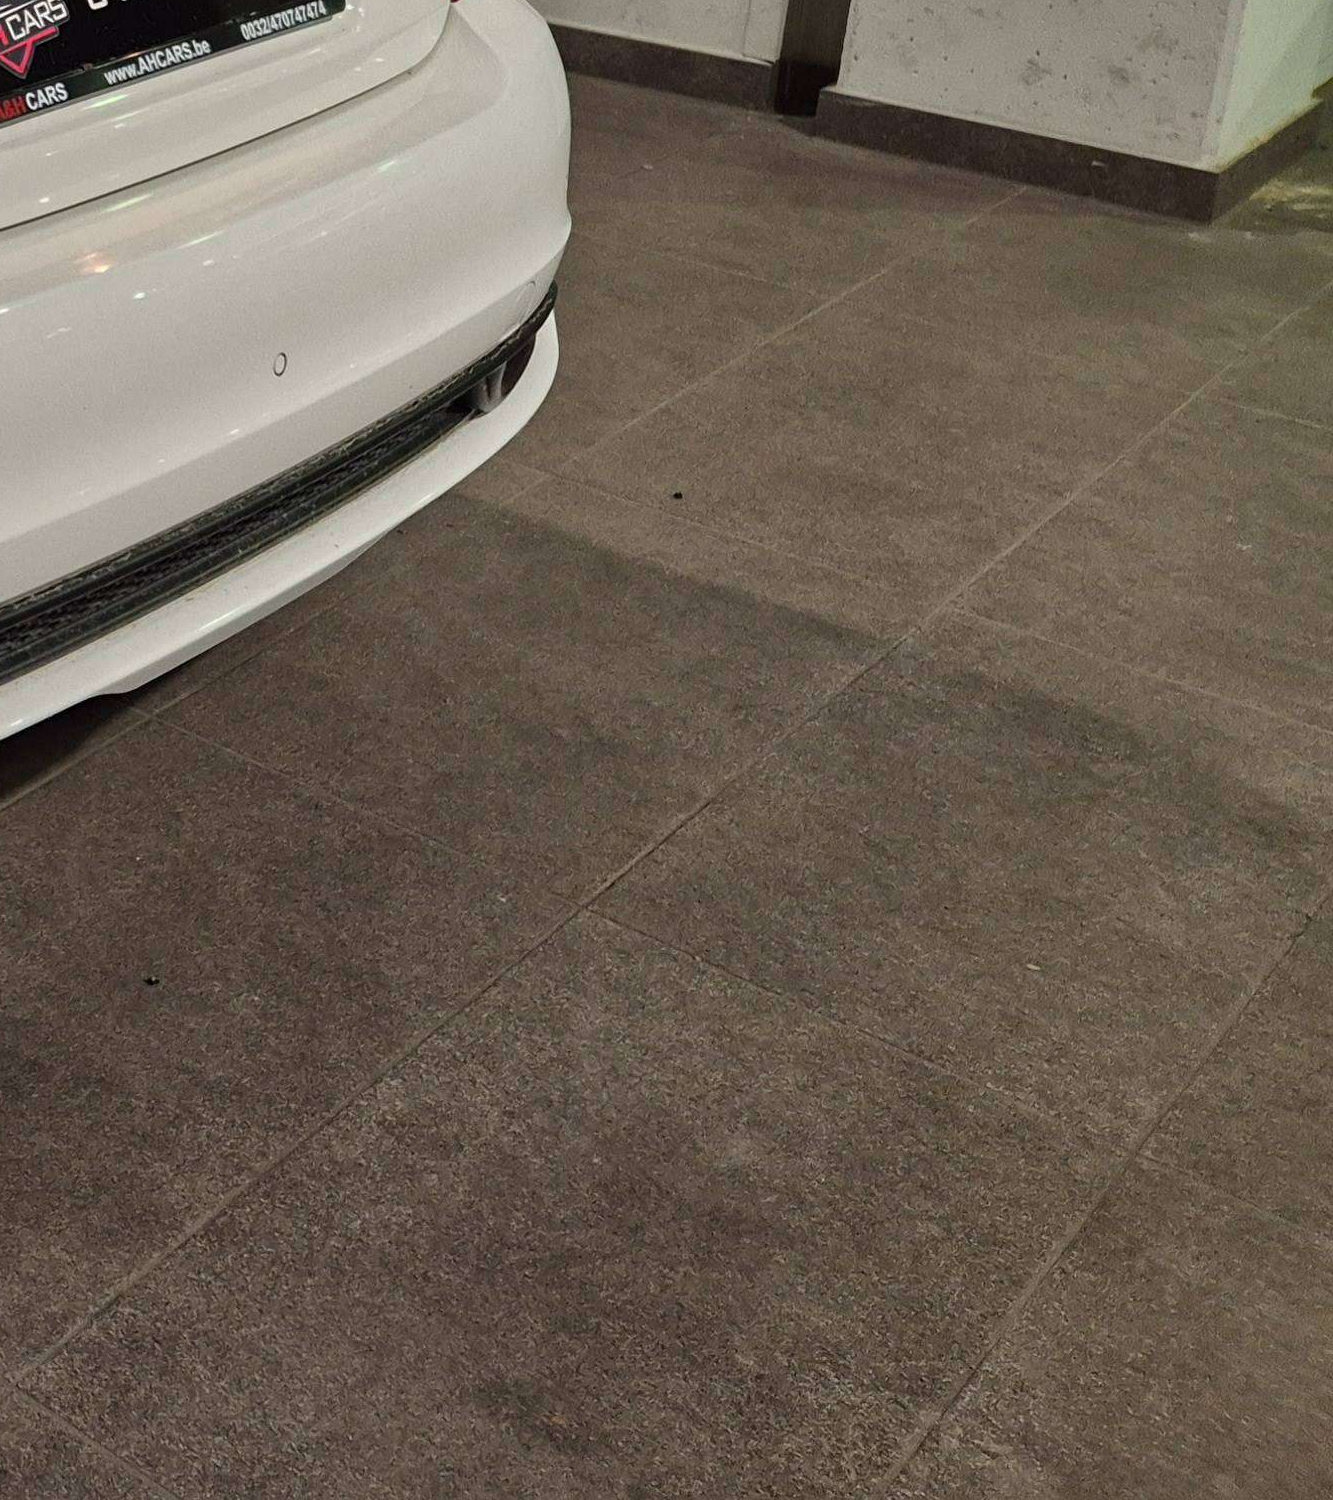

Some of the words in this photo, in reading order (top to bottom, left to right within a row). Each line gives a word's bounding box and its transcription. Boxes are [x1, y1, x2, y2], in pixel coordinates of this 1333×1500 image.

[239, 0, 327, 41] 0032/470747474
[103, 38, 212, 88] www.AHCARS.be
[24, 82, 69, 112] CARS
